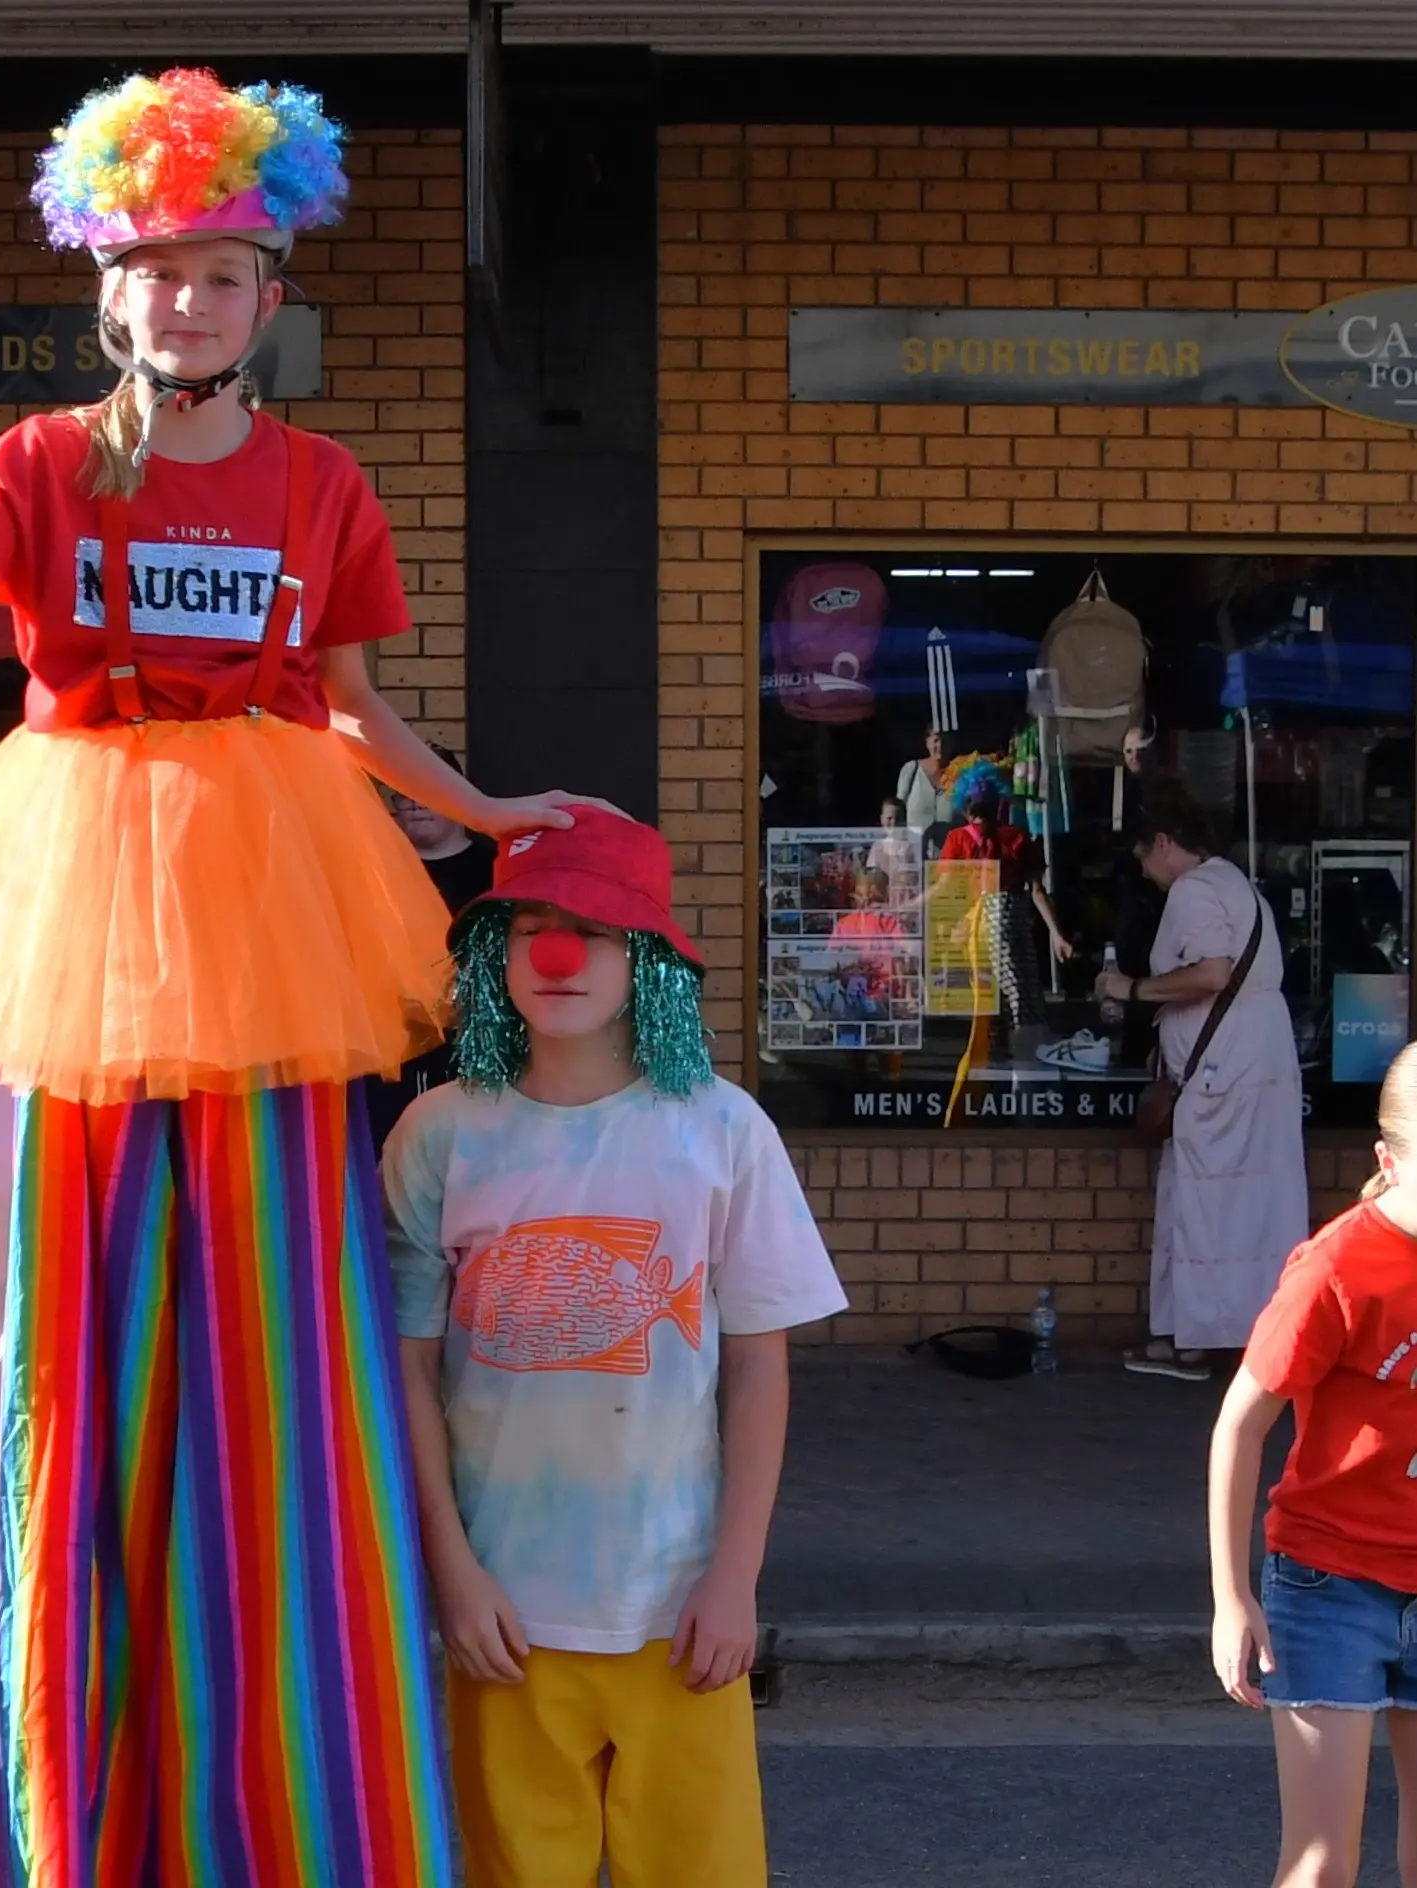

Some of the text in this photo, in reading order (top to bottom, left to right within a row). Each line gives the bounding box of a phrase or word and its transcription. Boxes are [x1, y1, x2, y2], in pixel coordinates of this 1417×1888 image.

[1337, 314, 1417, 359] CA
[900, 336, 1202, 378] SPORTSWEAR
[1367, 361, 1417, 390] FO
[165, 525, 232, 540] KINDA
[83, 559, 281, 617] NAUGHT
[1336, 1020, 1403, 1037] crocs
[964, 1092, 1065, 1116] LADIES
[1077, 1092, 1096, 1116] &
[1108, 1092, 1135, 1116] KI
